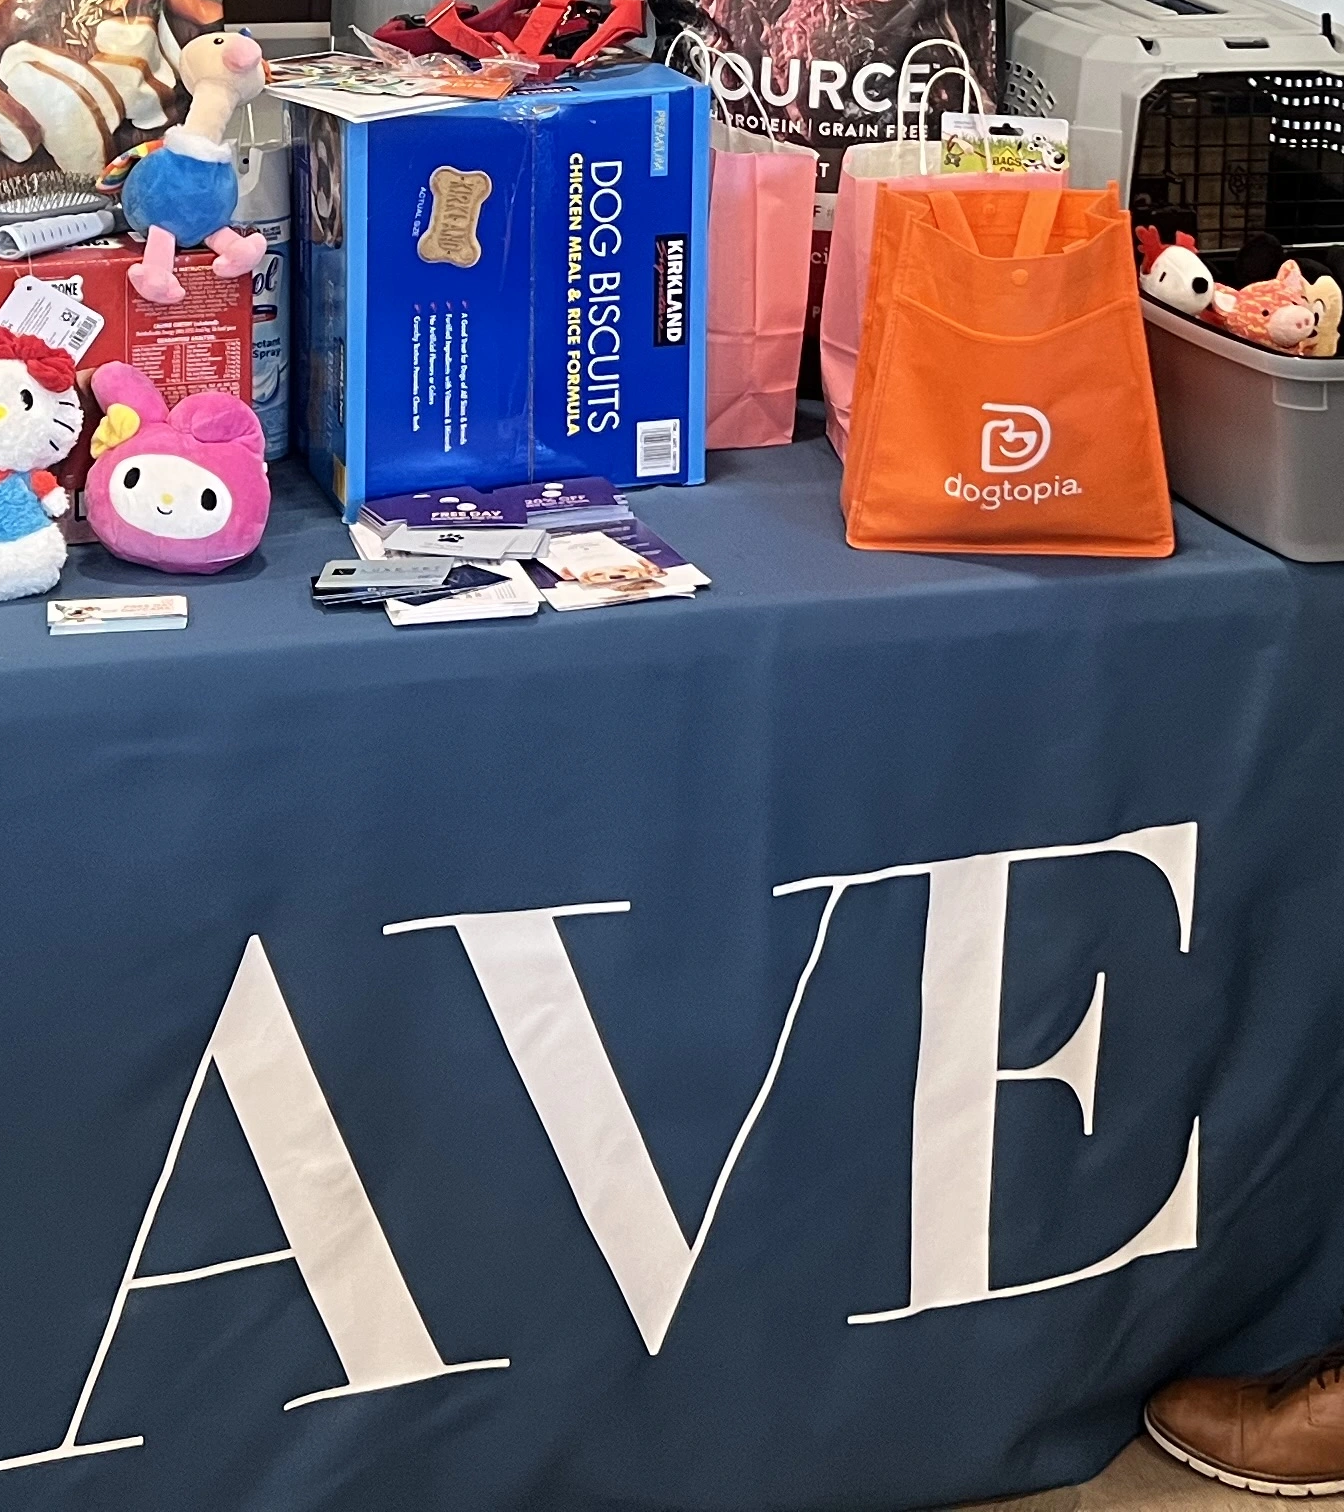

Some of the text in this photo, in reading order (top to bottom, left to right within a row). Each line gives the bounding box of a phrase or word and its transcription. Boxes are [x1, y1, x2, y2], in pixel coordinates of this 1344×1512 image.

[818, 123, 878, 138] GRAIN
[993, 157, 1021, 166] BAGS
[415, 187, 426, 218] ACTUAL
[438, 181, 474, 252] KIRKLAND
[566, 153, 584, 437] CHICKEN MEAL & RICE FORMULA
[587, 160, 623, 433] DOG BISCUITS
[666, 240, 684, 342] KIRKLAND
[252, 338, 280, 349] ectant
[253, 347, 280, 360] Spray
[431, 510, 466, 518] FREE
